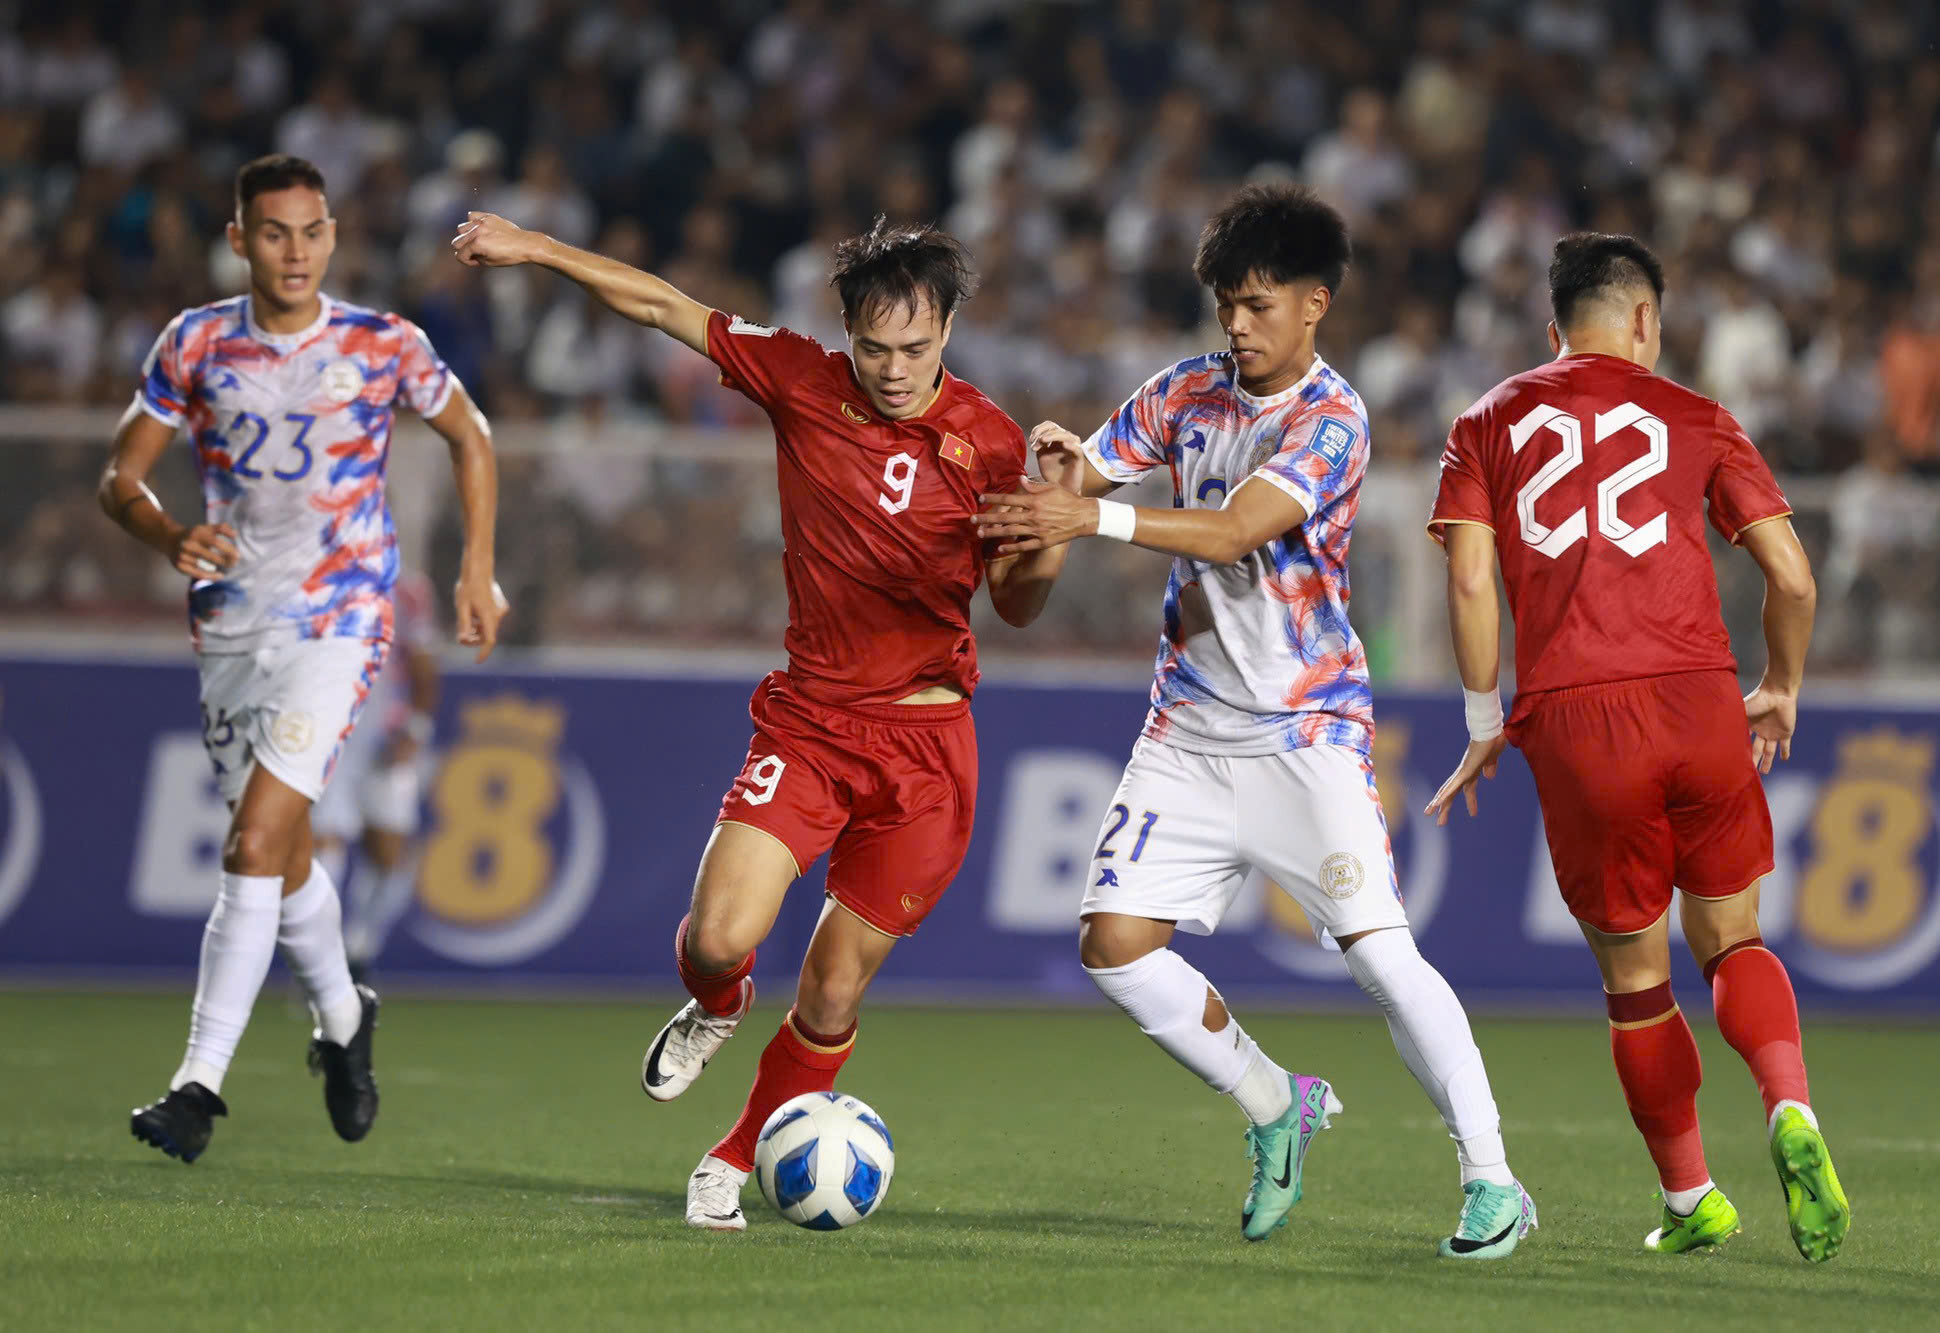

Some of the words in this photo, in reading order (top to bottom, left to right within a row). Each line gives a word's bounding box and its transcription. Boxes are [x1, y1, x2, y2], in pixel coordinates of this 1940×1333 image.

[230, 409, 317, 481] 23
[878, 452, 918, 515] 9
[1508, 401, 1669, 560] 22
[742, 754, 787, 806] 9
[1094, 804, 1160, 863] 21
